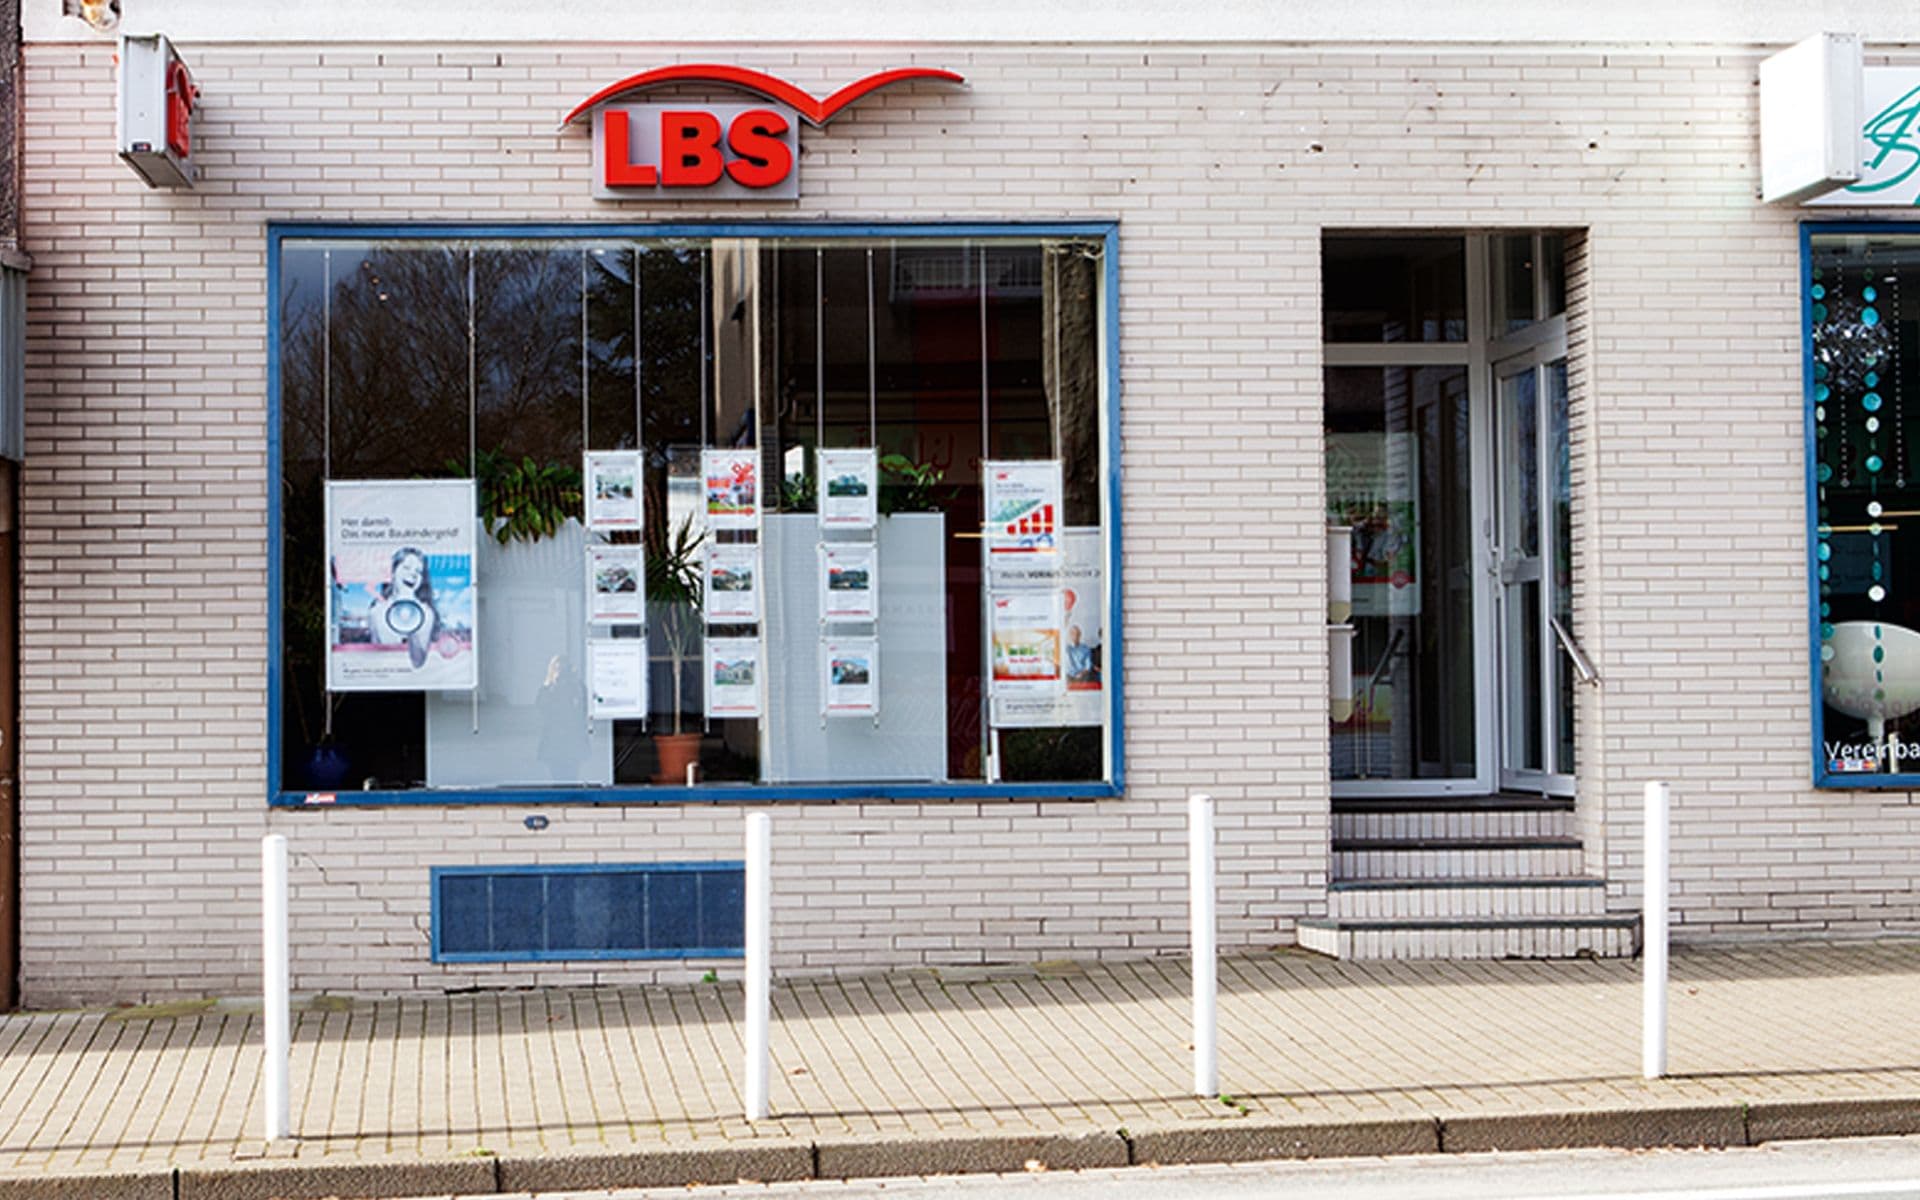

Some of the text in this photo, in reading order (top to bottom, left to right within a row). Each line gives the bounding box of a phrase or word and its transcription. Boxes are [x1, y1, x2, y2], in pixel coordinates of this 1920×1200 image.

[604, 109, 793, 188] LBS
[341, 529, 359, 539] Das
[361, 530, 385, 539] neue
